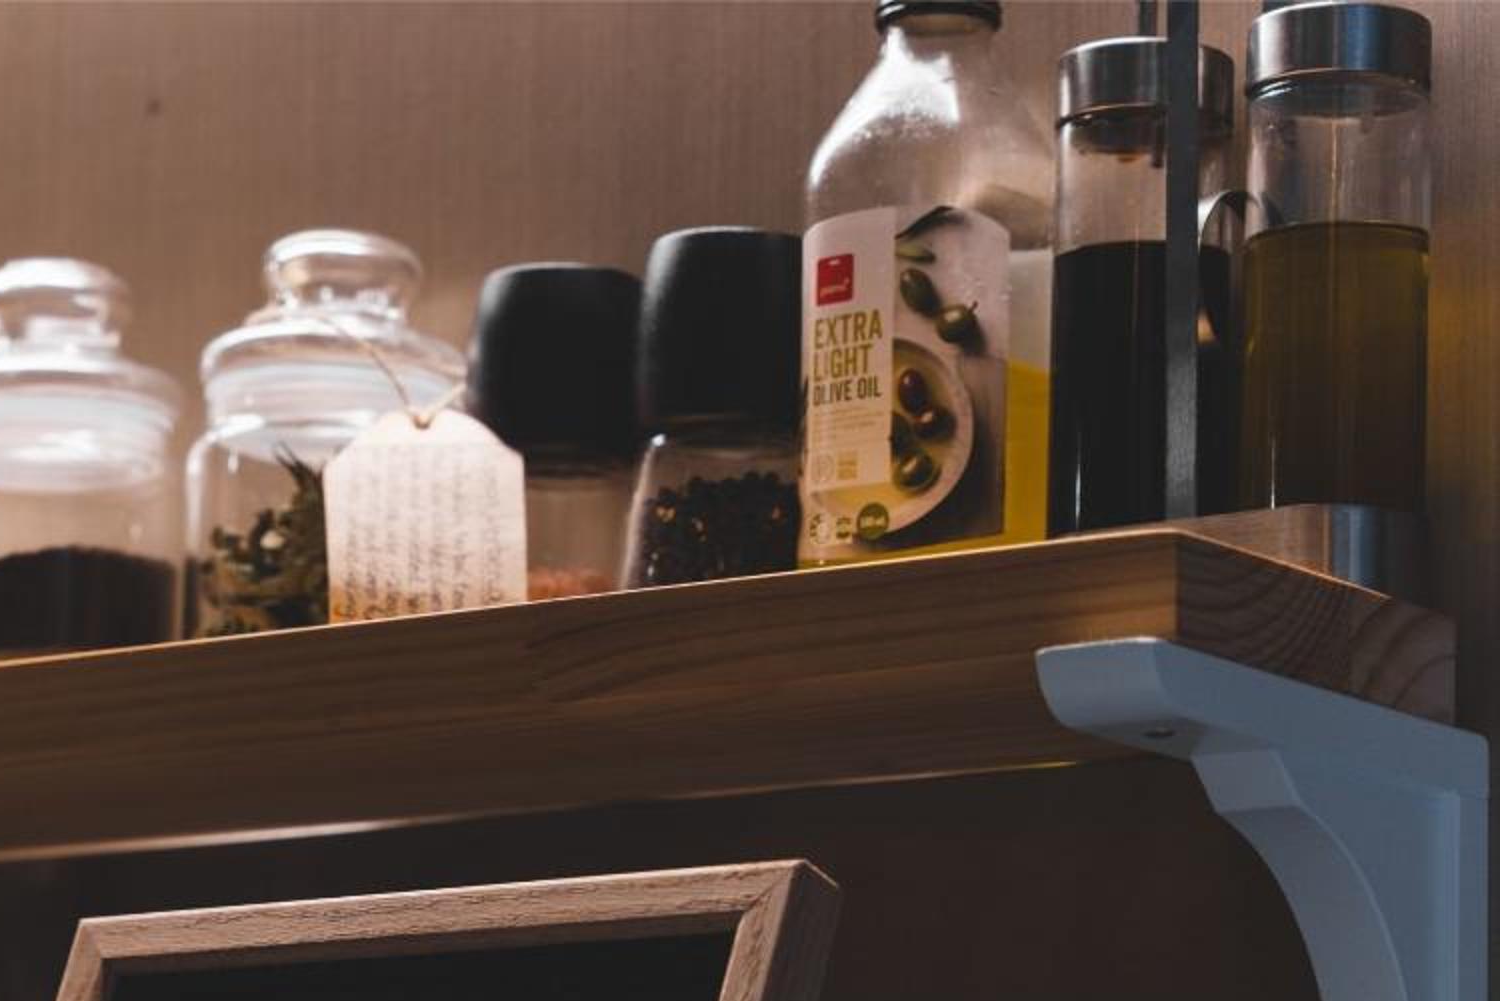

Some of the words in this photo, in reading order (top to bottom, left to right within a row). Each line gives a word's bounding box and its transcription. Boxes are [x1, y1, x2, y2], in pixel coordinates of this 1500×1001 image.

[814, 309, 882, 349] EXTRA
[813, 344, 872, 382] LIGHT
[813, 379, 852, 407] OLIVE
[857, 375, 881, 399] OIL
